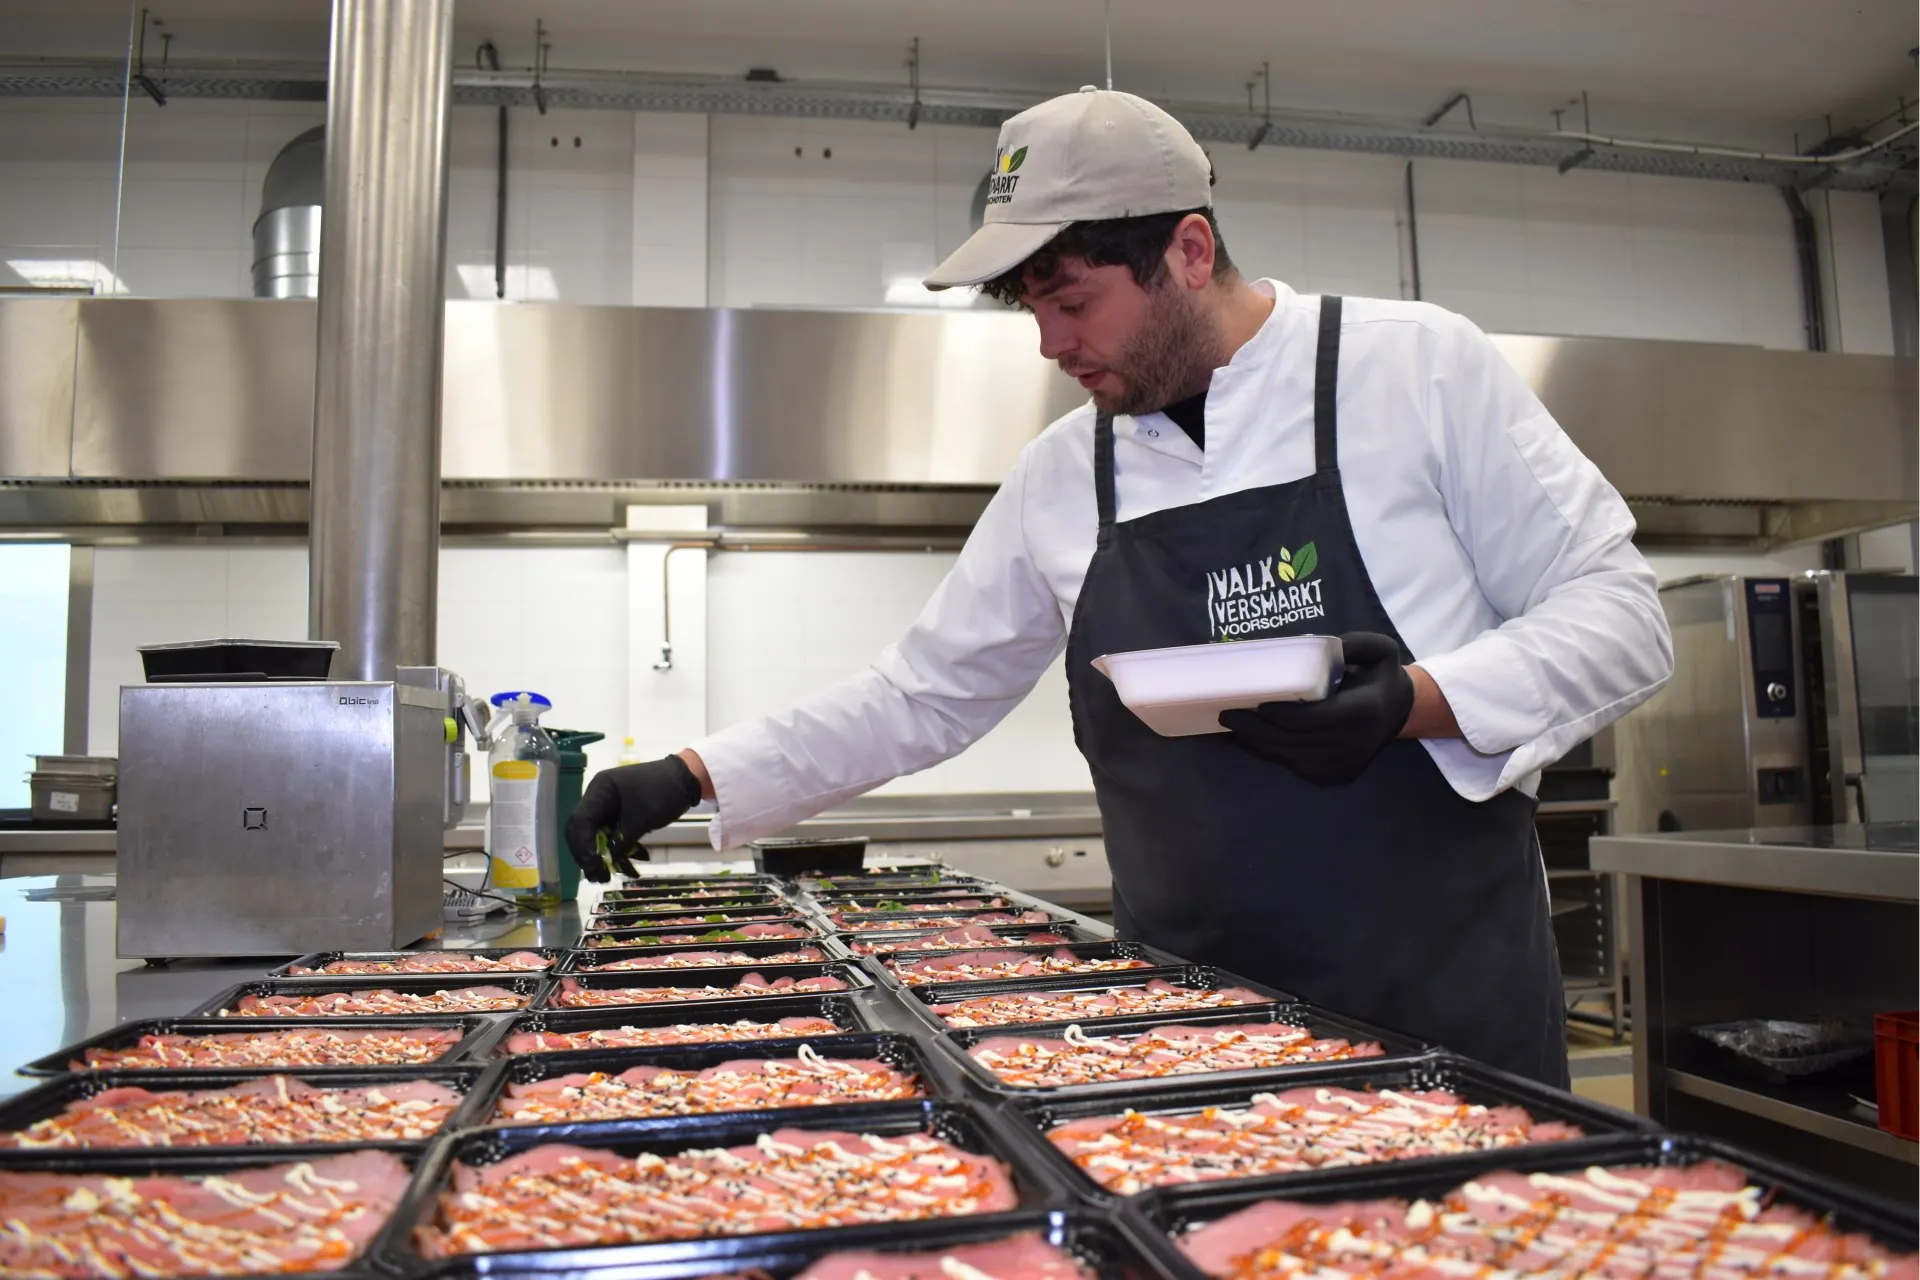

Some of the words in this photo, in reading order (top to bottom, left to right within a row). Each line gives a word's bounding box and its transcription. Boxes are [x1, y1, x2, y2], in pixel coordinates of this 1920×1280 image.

[1212, 555, 1276, 600] VALK
[1214, 578, 1322, 624] VERSMARKT
[1219, 604, 1325, 636] VOORSCHOTEN
[339, 696, 366, 705] Qbic
